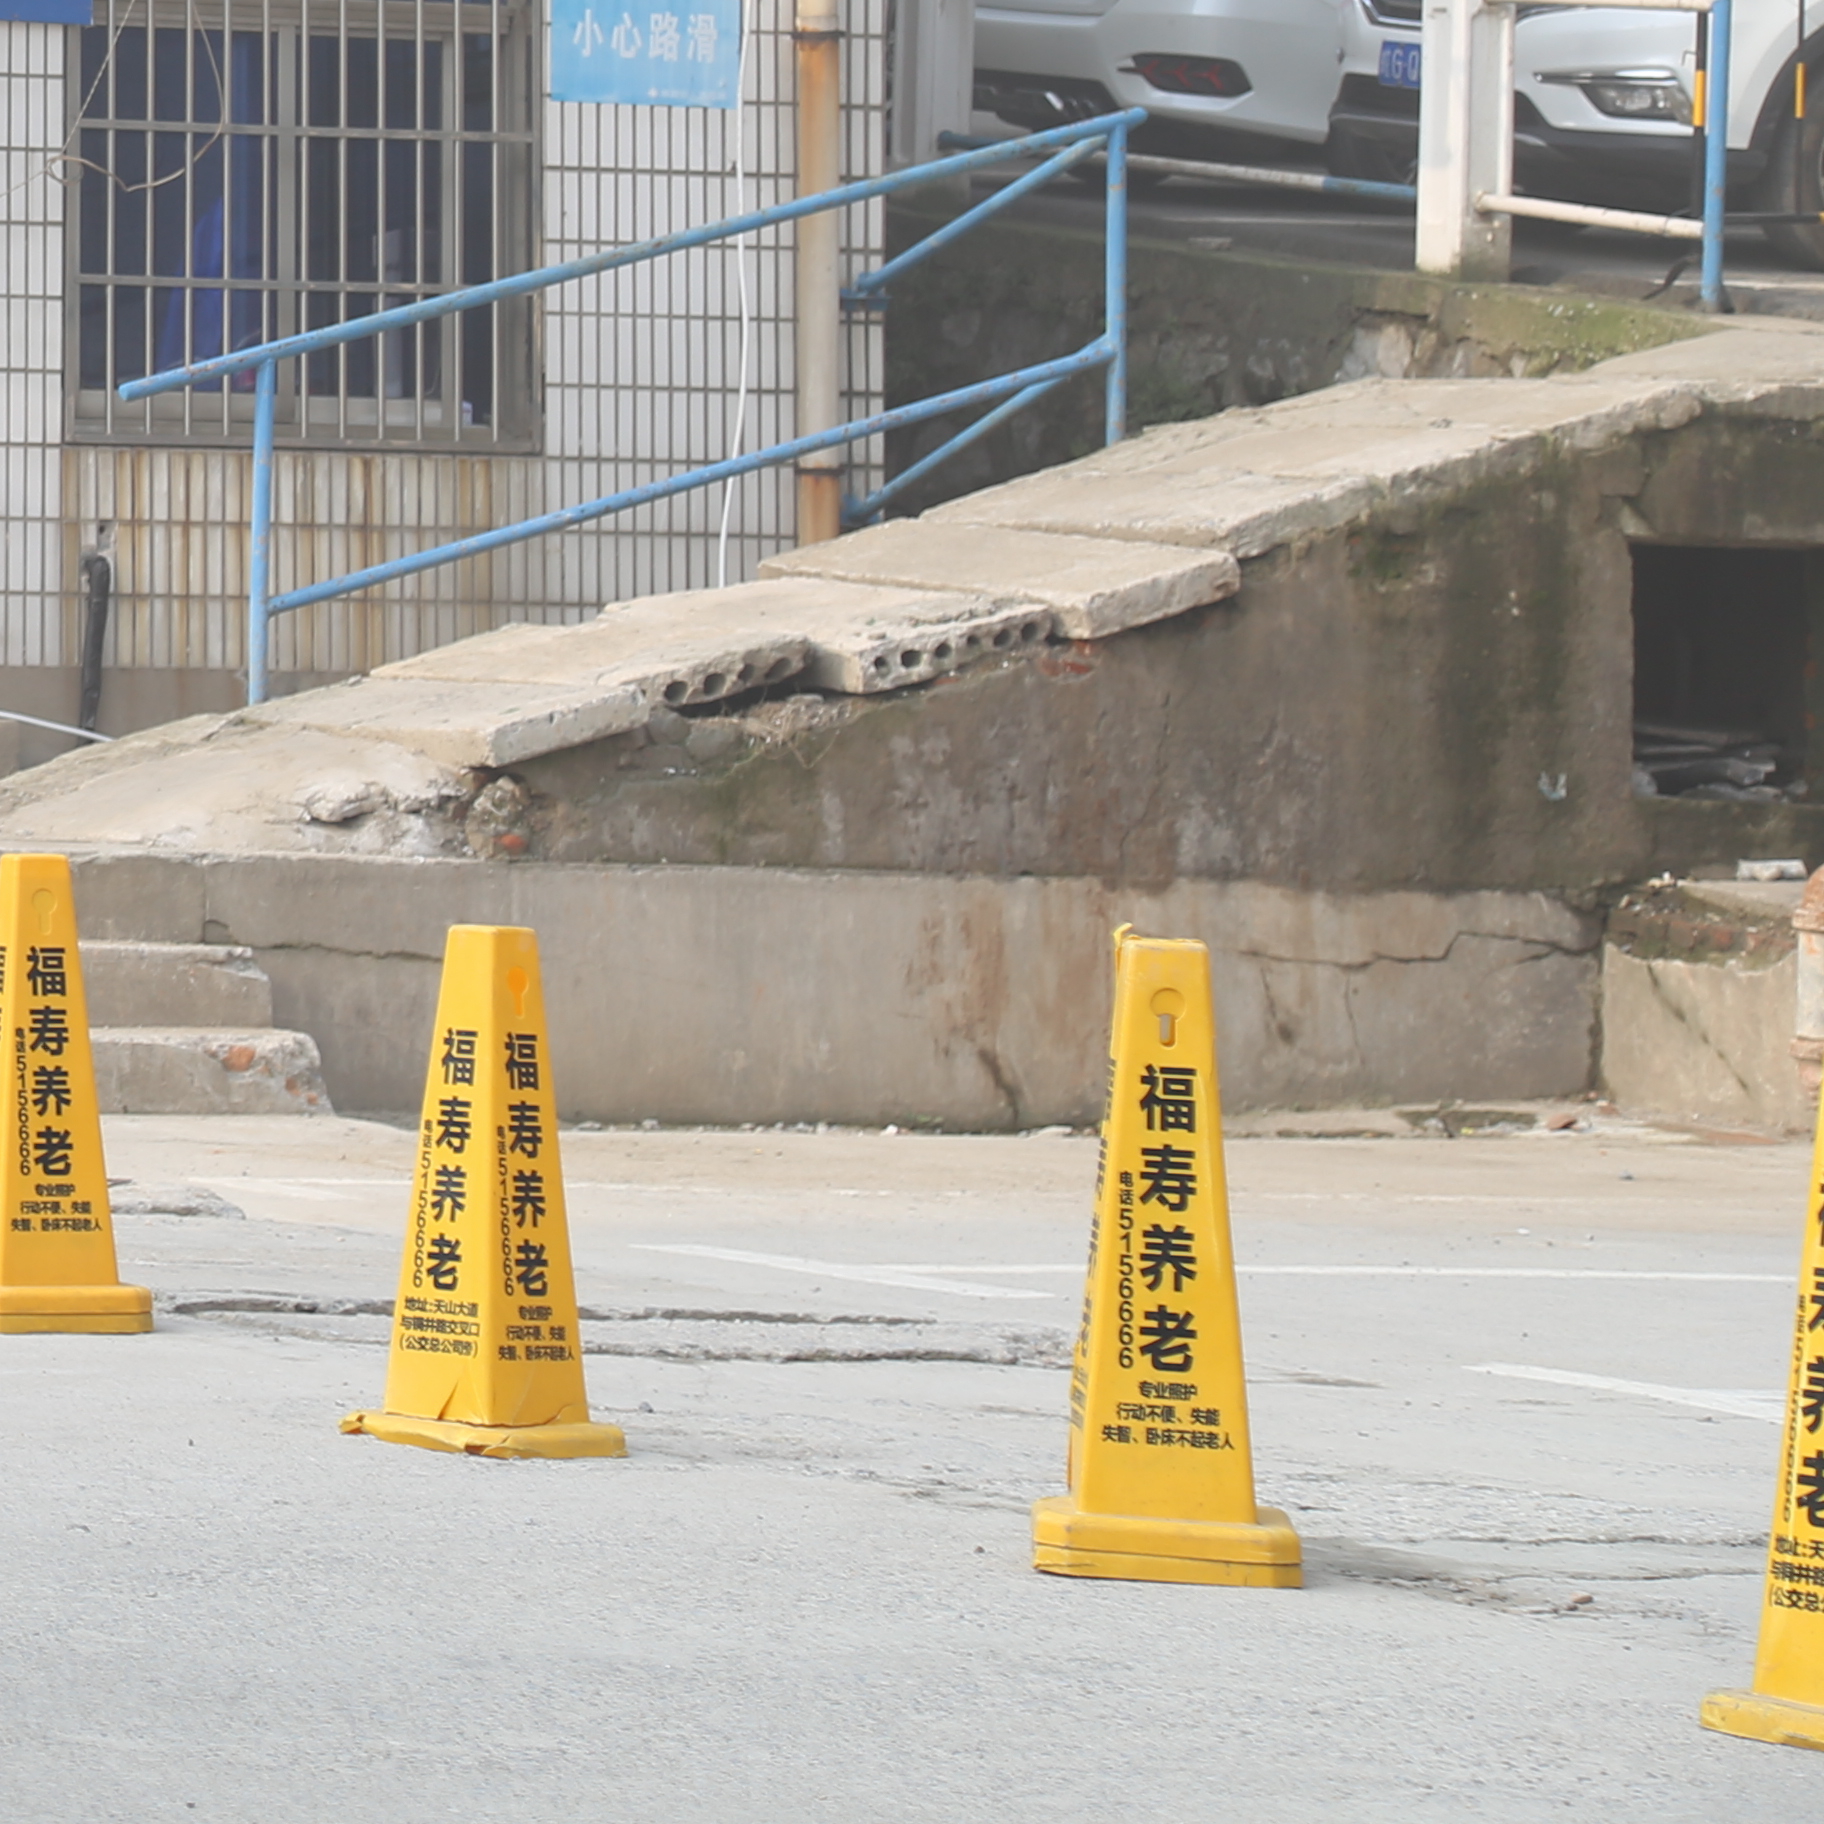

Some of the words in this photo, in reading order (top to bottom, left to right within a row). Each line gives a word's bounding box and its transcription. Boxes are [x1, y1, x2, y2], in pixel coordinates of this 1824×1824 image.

[573, 8, 718, 63] 小心路滑
[26, 946, 74, 1177] 福寿养老
[425, 1026, 479, 1293] 福寿养老
[504, 1031, 549, 1298] 福寿养老
[1117, 1170, 1135, 1370] 电话5156666
[1139, 1062, 1197, 1375] 福寿养老
[1139, 1380, 1197, 1401] 专业照护
